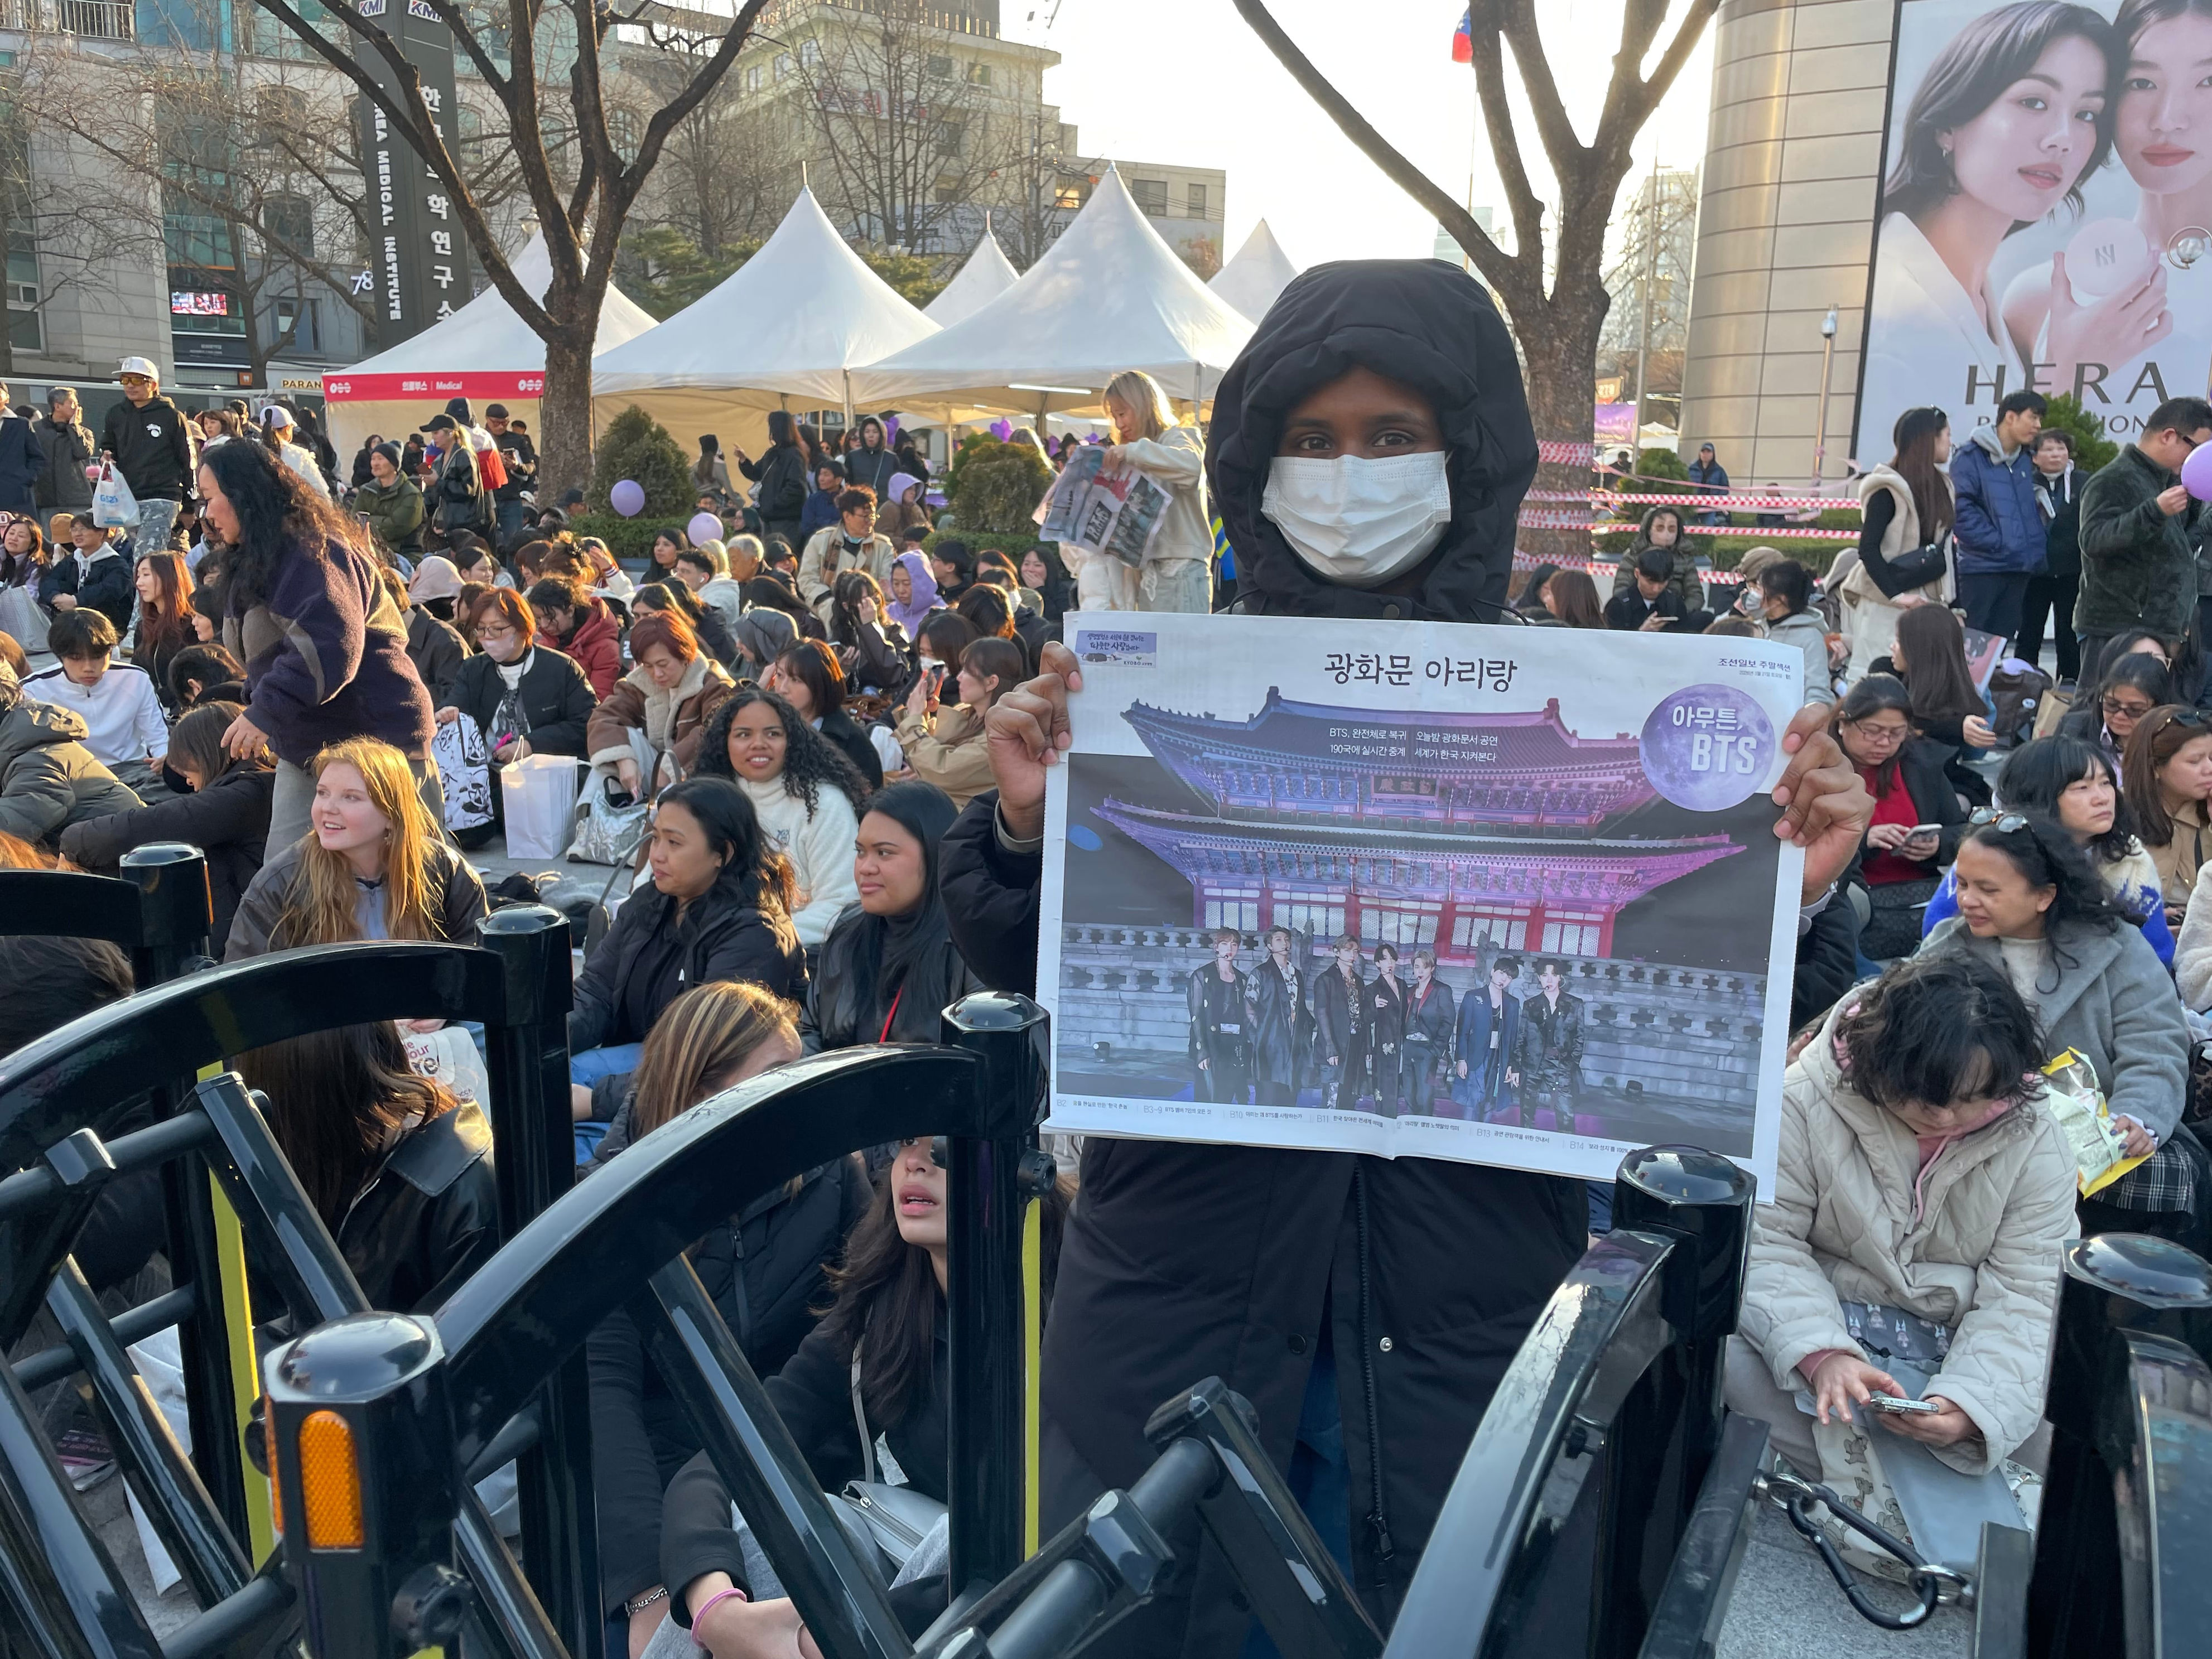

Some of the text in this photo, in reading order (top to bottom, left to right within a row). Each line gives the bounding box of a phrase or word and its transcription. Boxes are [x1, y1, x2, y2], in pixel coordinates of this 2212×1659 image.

[359, 0, 383, 16] KMI
[377, 150, 394, 226] MEDICAL
[420, 85, 456, 320] 한학연구소
[350, 271, 374, 295] 78
[384, 236, 402, 320] INSTITUTE
[282, 380, 322, 388] PARAN
[436, 381, 462, 390] Medical
[1965, 361, 2169, 404] HERA
[1324, 653, 1518, 692] 광화문 아리랑
[1718, 658, 1791, 672] 조선일보 주말섹션
[1673, 705, 1743, 731] 아무튼,
[1329, 728, 1498, 746] BTS, 완전체로 복귀 오늘밤 광화문서 공연
[1330, 744, 1496, 763] 190국에 실시간 중계 세계가 한국 지켜본다
[1691, 733, 1757, 774] BTS
[1230, 1111, 1243, 1119] B10
[1317, 1115, 1329, 1123] B11
[1477, 1128, 1491, 1137] B13
[1570, 1141, 1584, 1150] B14
